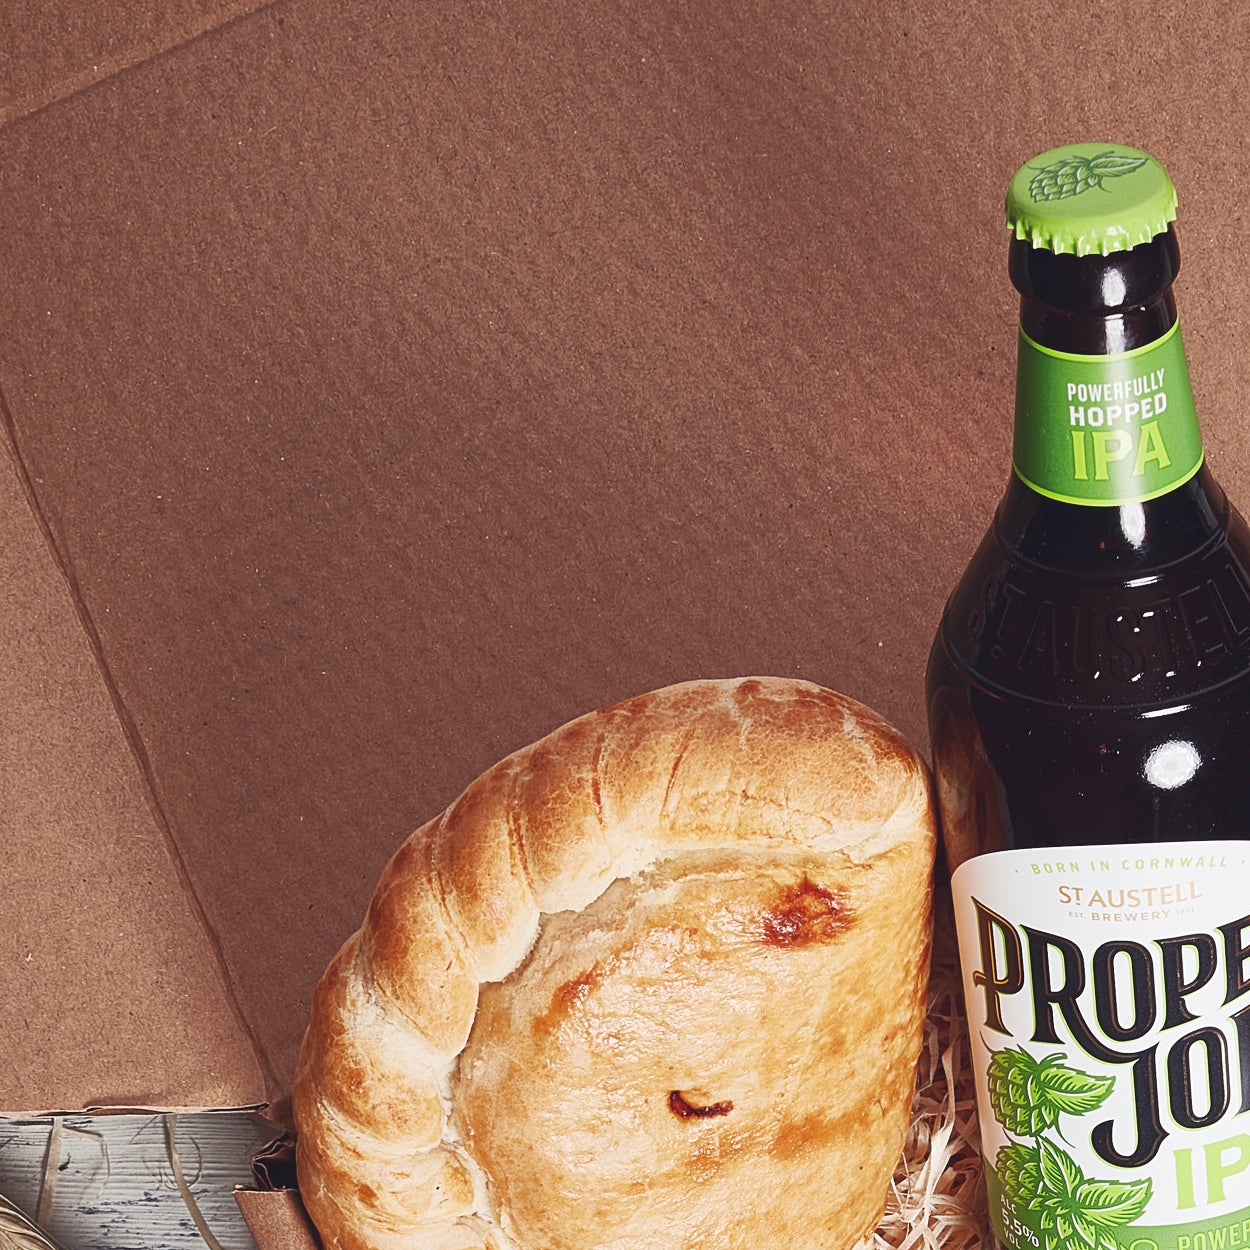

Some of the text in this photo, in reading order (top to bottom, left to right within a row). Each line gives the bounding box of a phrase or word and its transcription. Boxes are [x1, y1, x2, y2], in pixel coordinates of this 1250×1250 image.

[1067, 368, 1165, 402] POWERFULLY
[1069, 392, 1167, 427] HOPPED
[1071, 420, 1171, 480] IPA
[1030, 855, 1228, 875] BORN IN CORNWALL
[1088, 880, 1203, 908] AUSTELL
[1091, 909, 1171, 922] BREWERY
[1001, 1194, 1017, 1215] ALC
[1002, 1208, 1040, 1247] 5.5%
[1004, 1227, 1021, 1249] VOL
